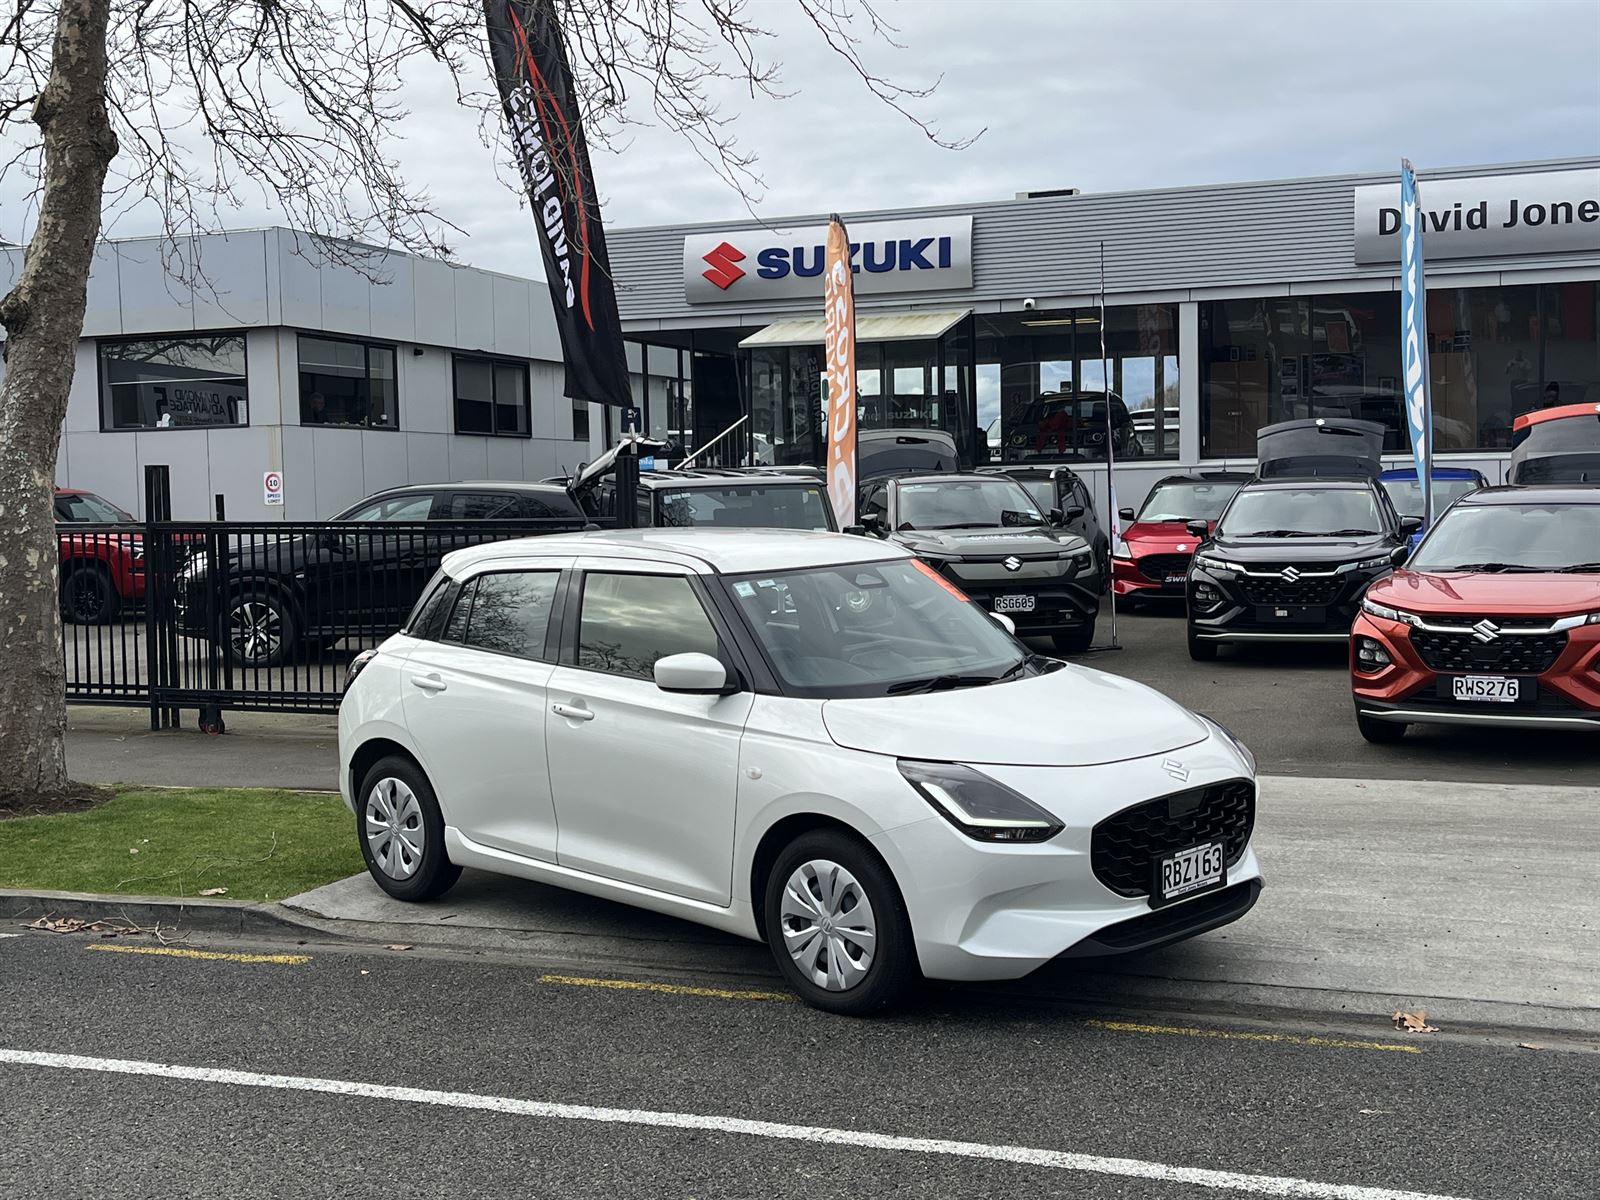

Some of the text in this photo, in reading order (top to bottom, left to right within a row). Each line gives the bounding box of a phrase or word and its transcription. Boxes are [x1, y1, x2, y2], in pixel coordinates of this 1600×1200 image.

[1379, 200, 1487, 235] Dvid
[269, 479, 278, 487] 10
[996, 598, 1034, 609] RSG605
[1455, 680, 1517, 696] RWS276
[1164, 847, 1222, 890] RBZ163
